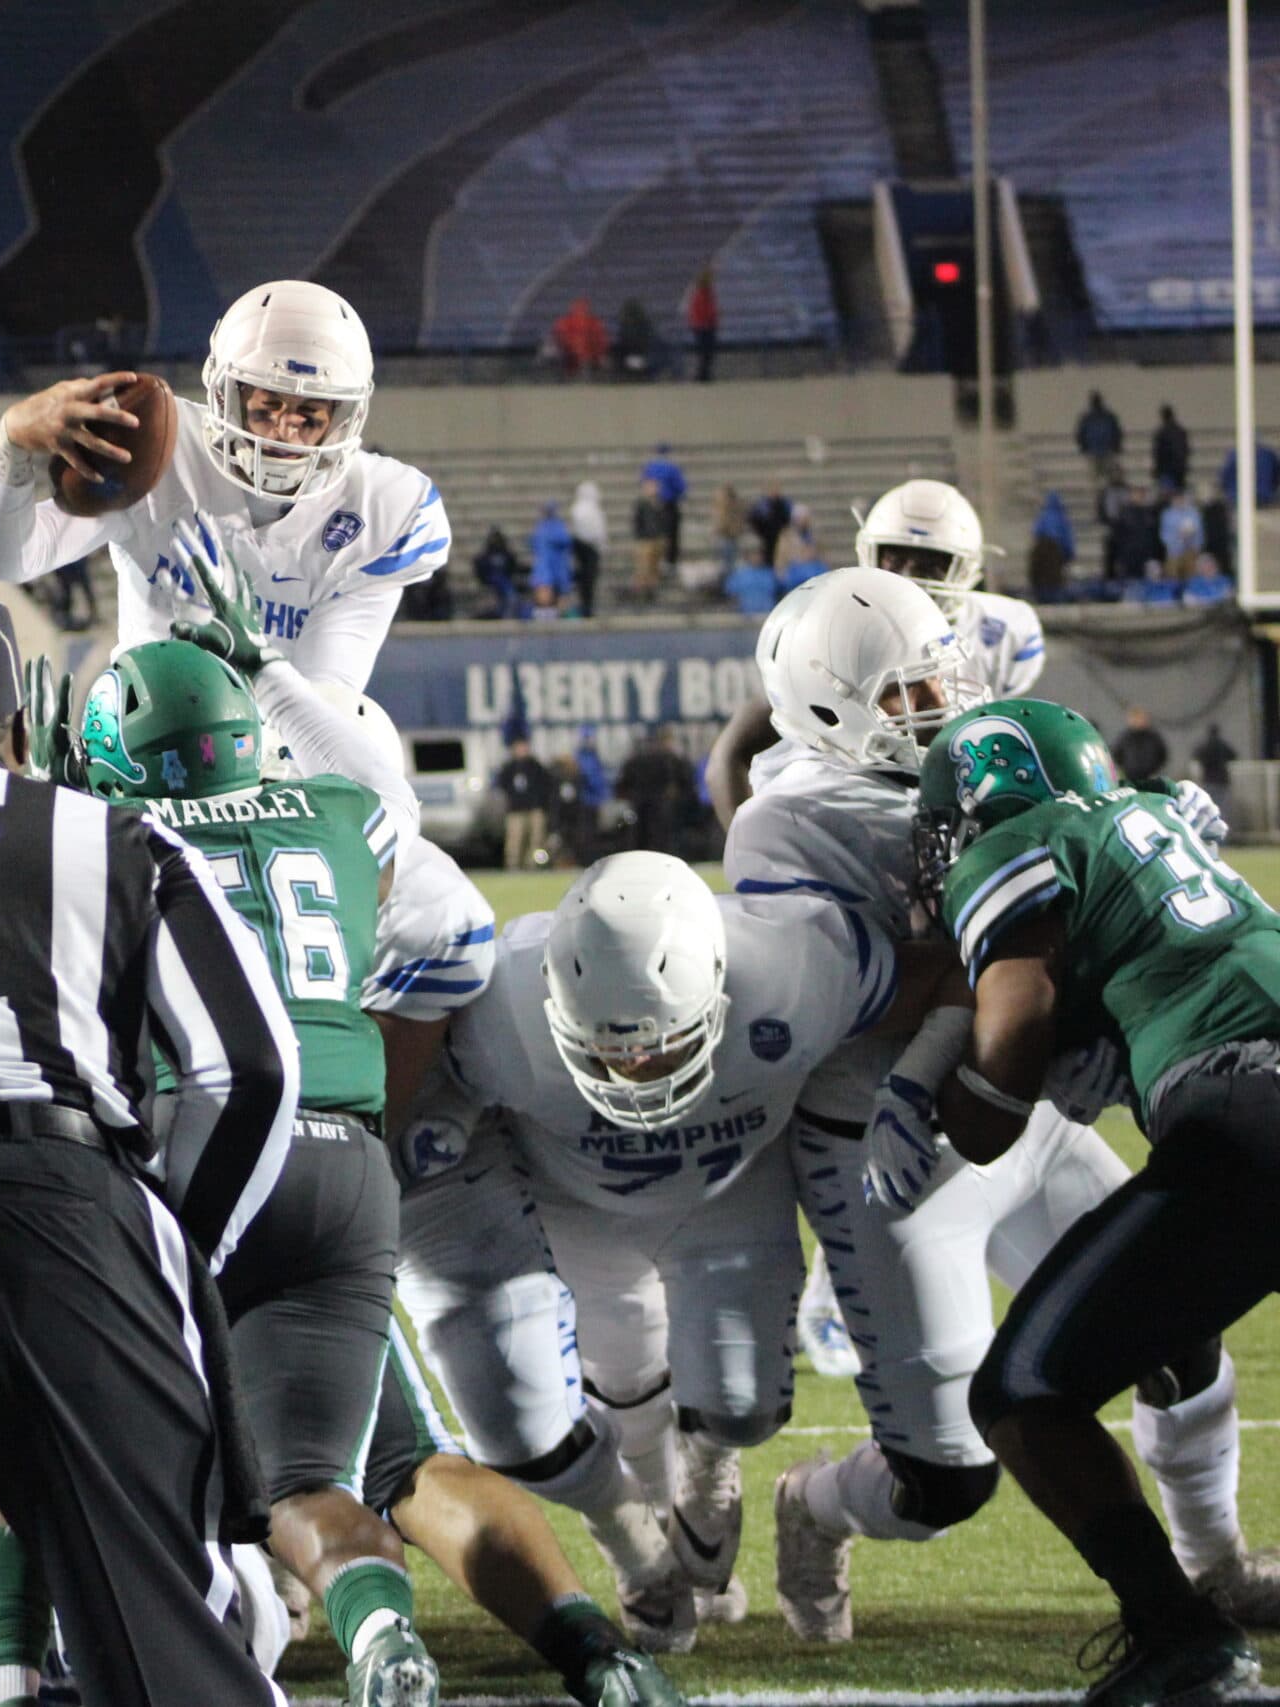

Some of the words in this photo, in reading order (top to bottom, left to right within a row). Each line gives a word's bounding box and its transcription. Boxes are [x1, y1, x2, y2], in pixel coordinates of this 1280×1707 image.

[144, 787, 316, 829] MARBLEY
[307, 1119, 349, 1141] WAVE
[580, 1105, 767, 1153] MEMPHIS
